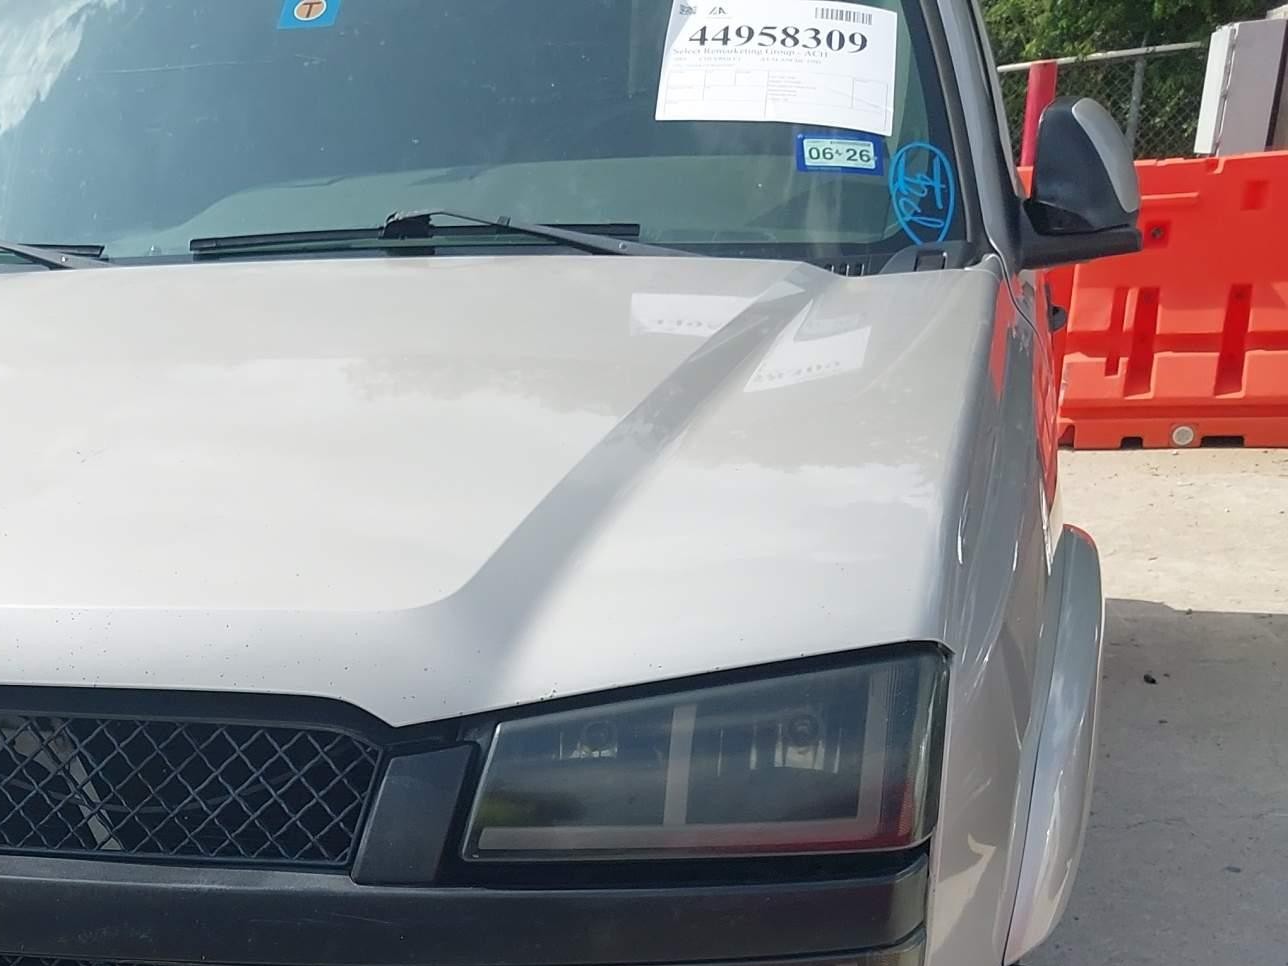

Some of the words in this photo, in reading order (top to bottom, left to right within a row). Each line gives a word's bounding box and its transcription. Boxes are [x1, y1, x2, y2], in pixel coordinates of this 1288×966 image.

[302, 2, 322, 18] T
[688, 25, 868, 54] 44958309
[808, 147, 834, 160] 06
[846, 148, 871, 163] 26
